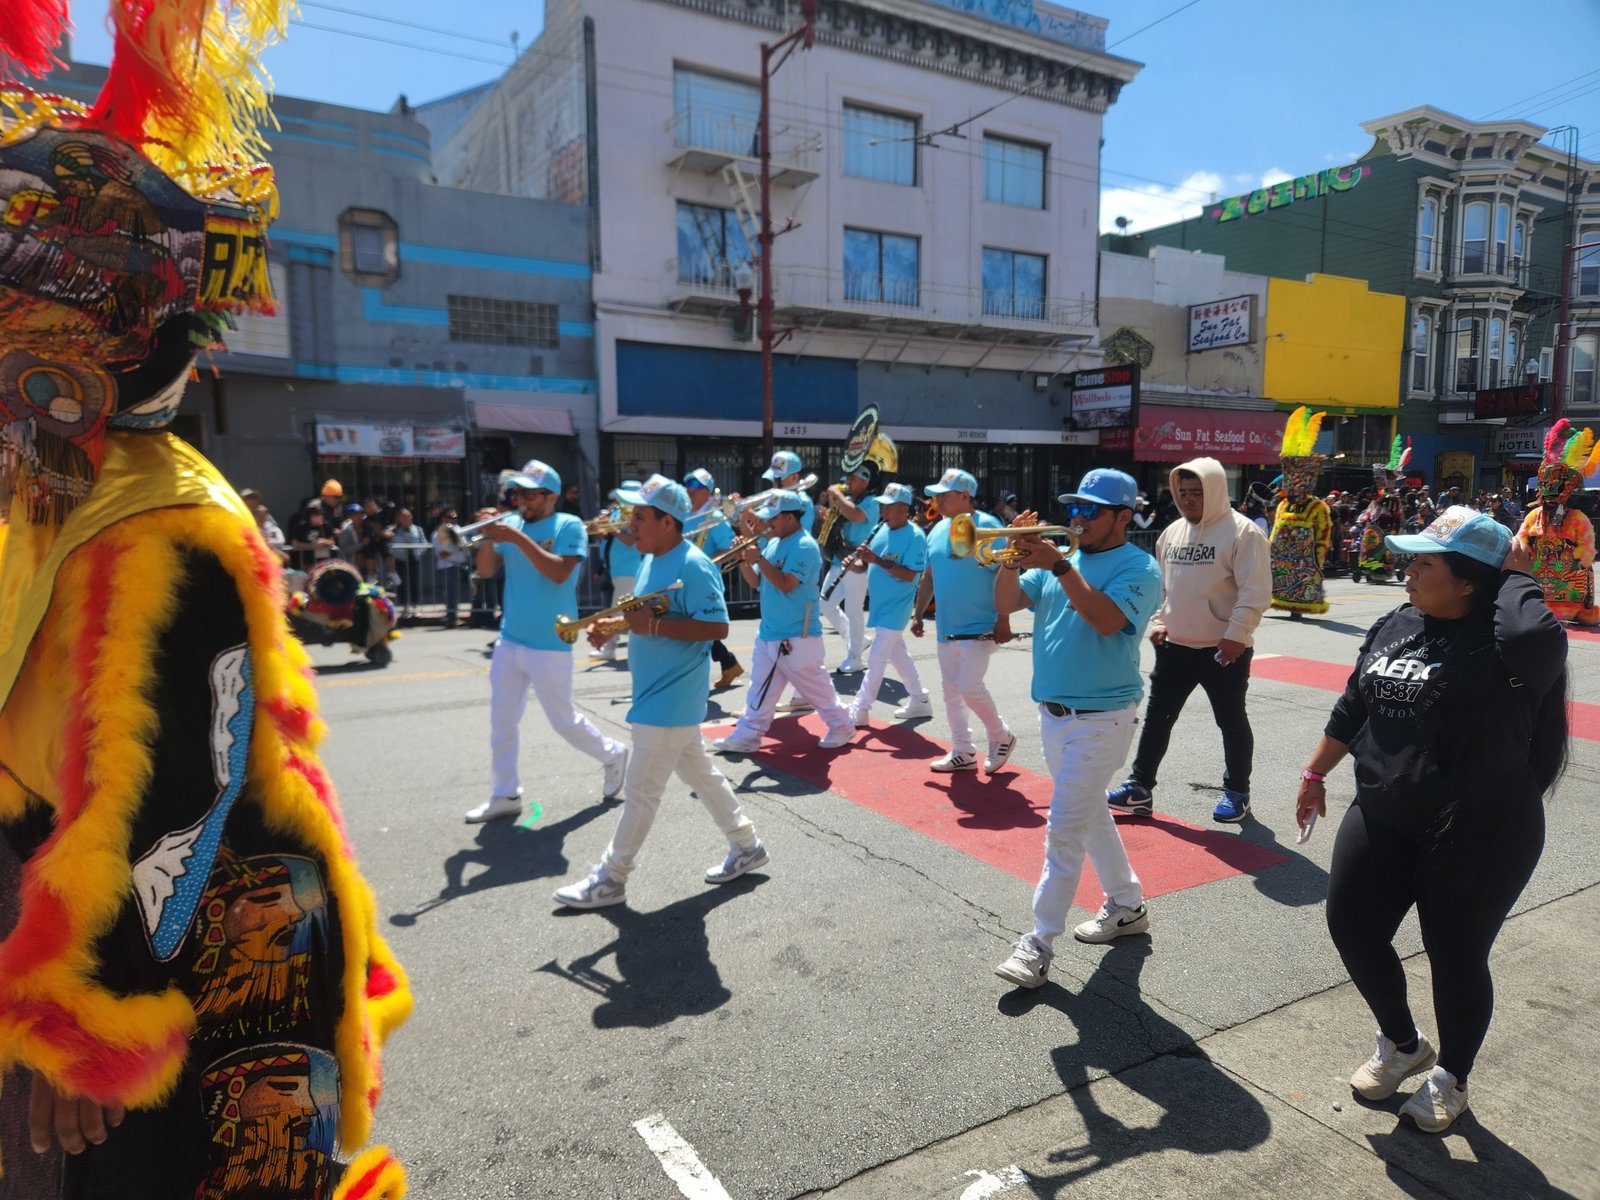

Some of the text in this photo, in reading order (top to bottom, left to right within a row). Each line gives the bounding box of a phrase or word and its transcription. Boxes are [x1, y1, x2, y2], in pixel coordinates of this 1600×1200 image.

[1200, 316, 1240, 333] Sun Fat
[1191, 329, 1231, 346] Seafood
[1075, 369, 1130, 387] GameStop
[1476, 388, 1539, 415] BAR
[784, 426, 807, 435] 2673
[1175, 428, 1262, 444] Sun Fat Seafood Co.
[1503, 431, 1534, 440] Norma
[1498, 440, 1537, 450] HOTEL
[1373, 679, 1424, 703] 1987
